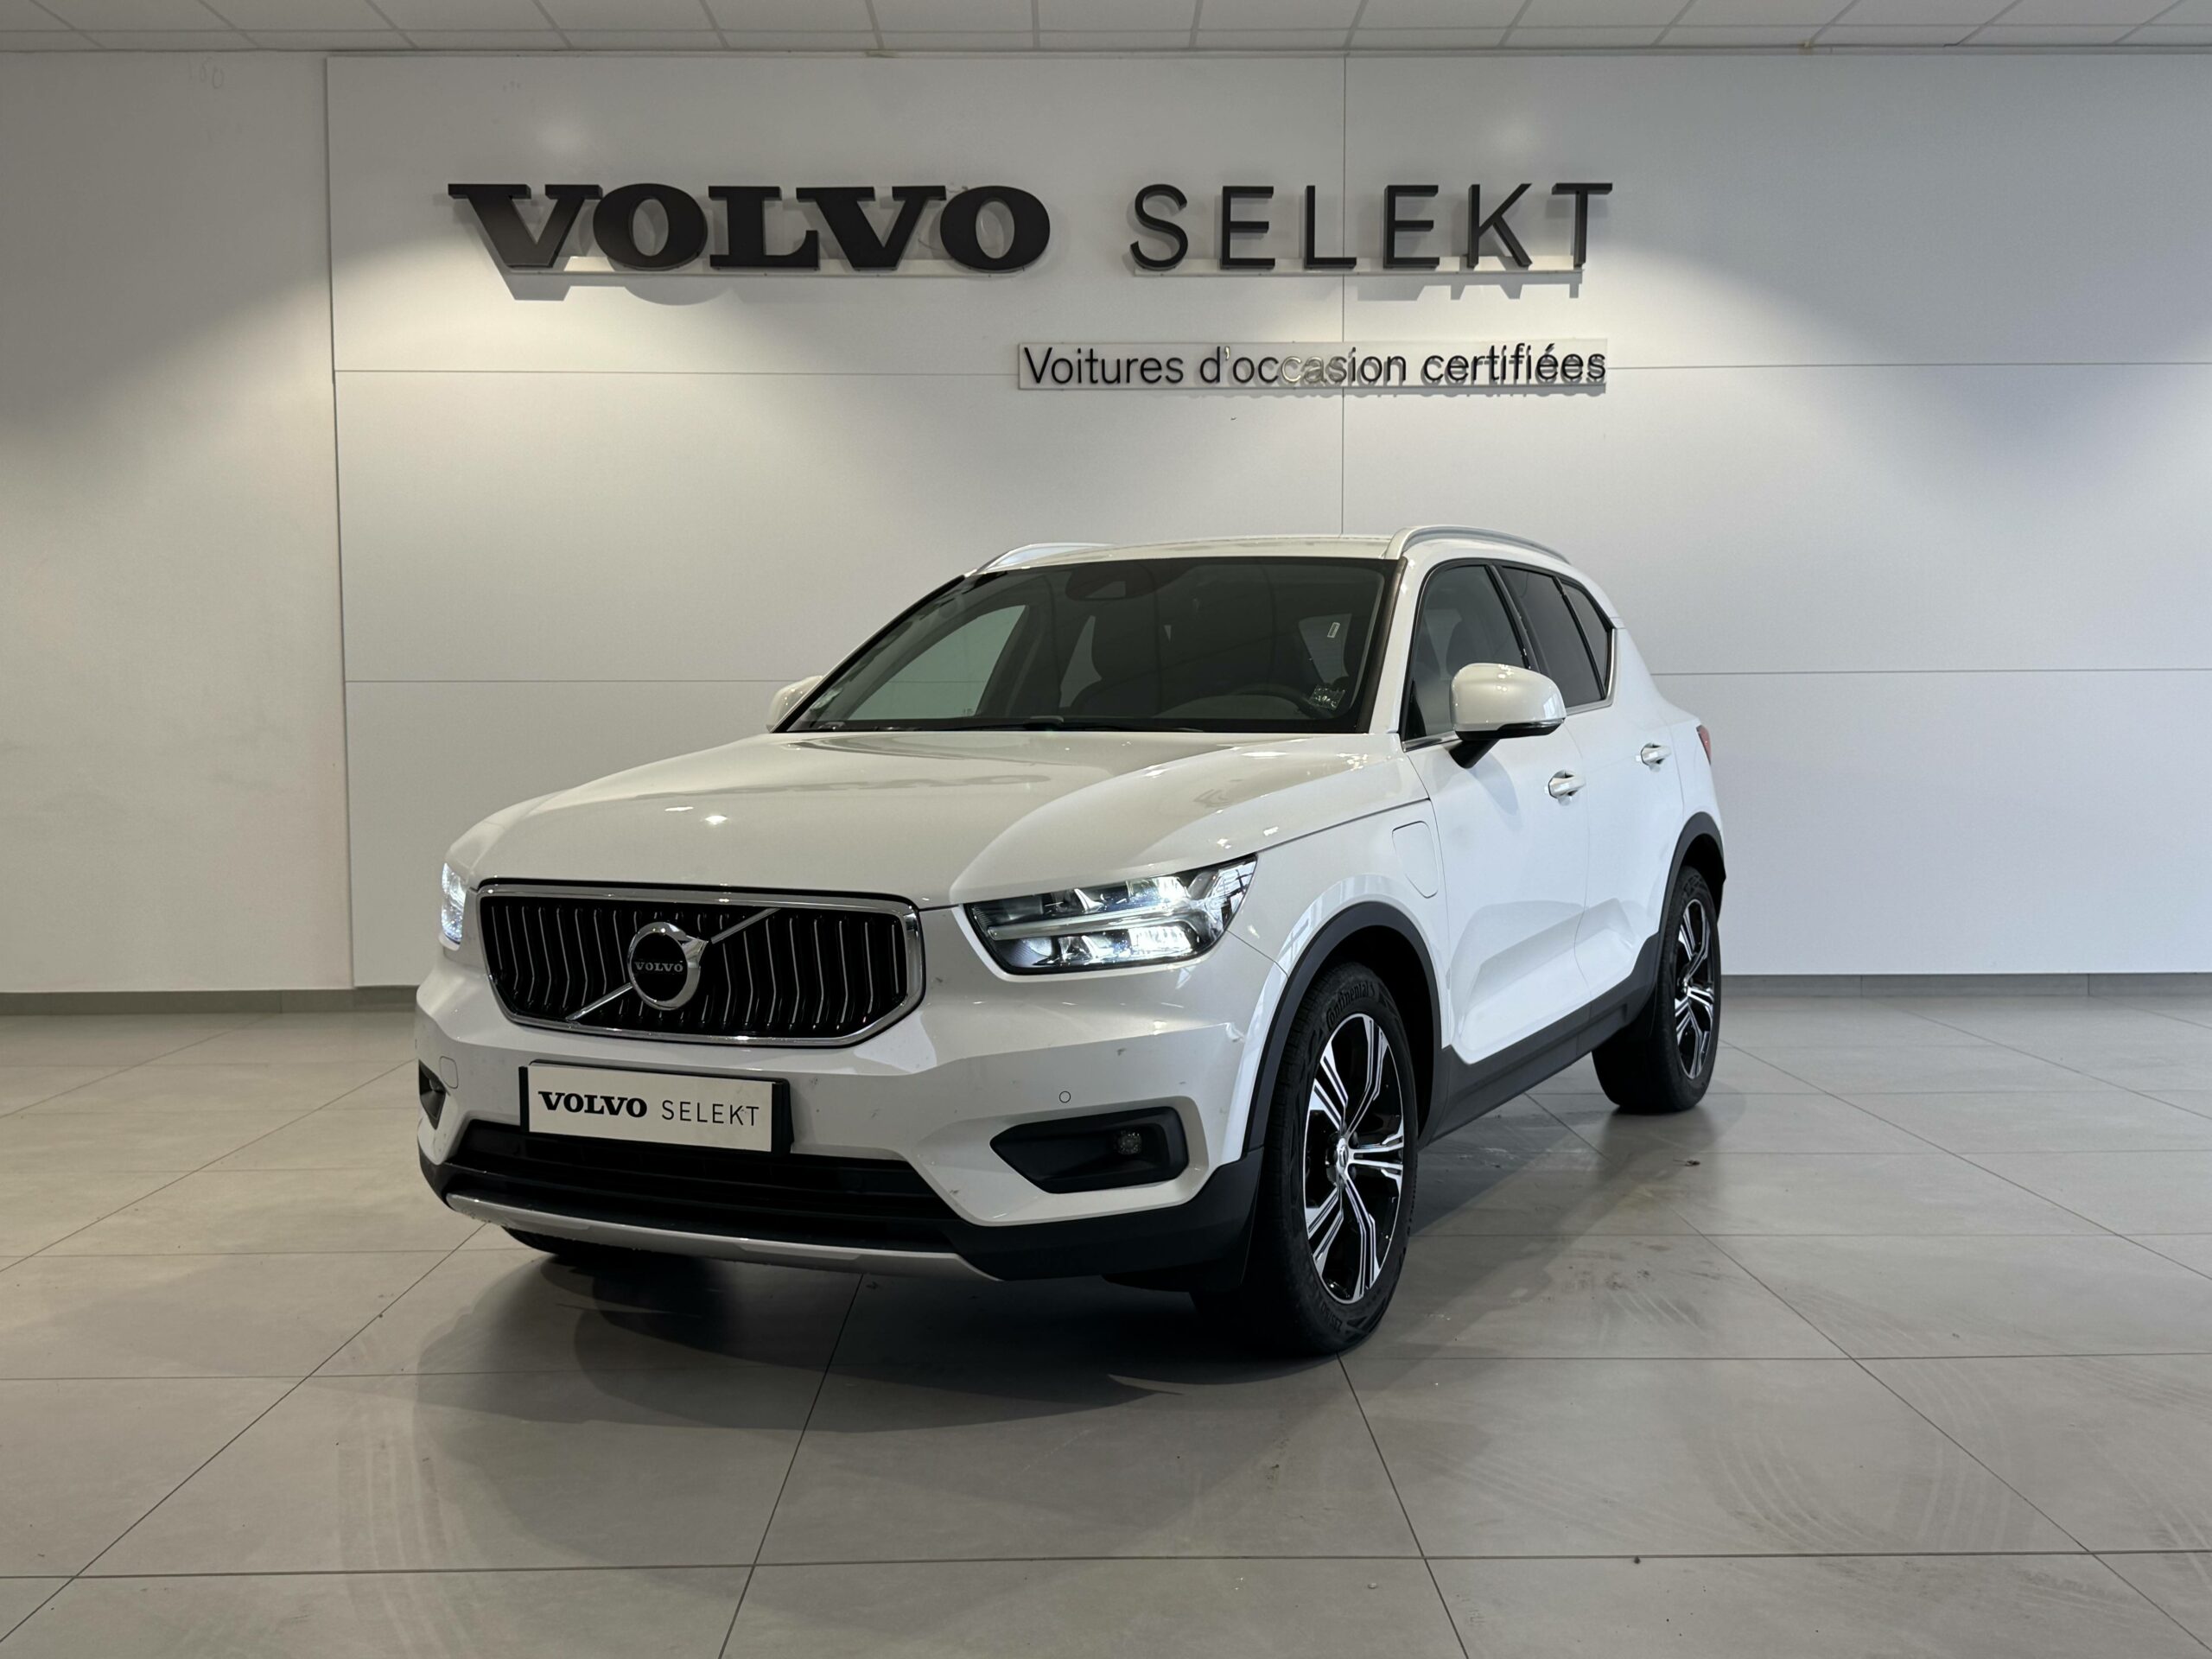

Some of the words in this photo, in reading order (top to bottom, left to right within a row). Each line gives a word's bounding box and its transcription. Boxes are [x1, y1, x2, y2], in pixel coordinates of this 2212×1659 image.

[448, 183, 1051, 271] VOLVO
[1129, 182, 1613, 270] SELEKT
[1024, 346, 1185, 385] Voitures
[1198, 346, 1408, 384] d'occasion
[1422, 343, 1607, 382] certifiées
[634, 961, 683, 973] VOLVO
[537, 1090, 648, 1118] VOLVO
[661, 1099, 760, 1127] SELEKT
